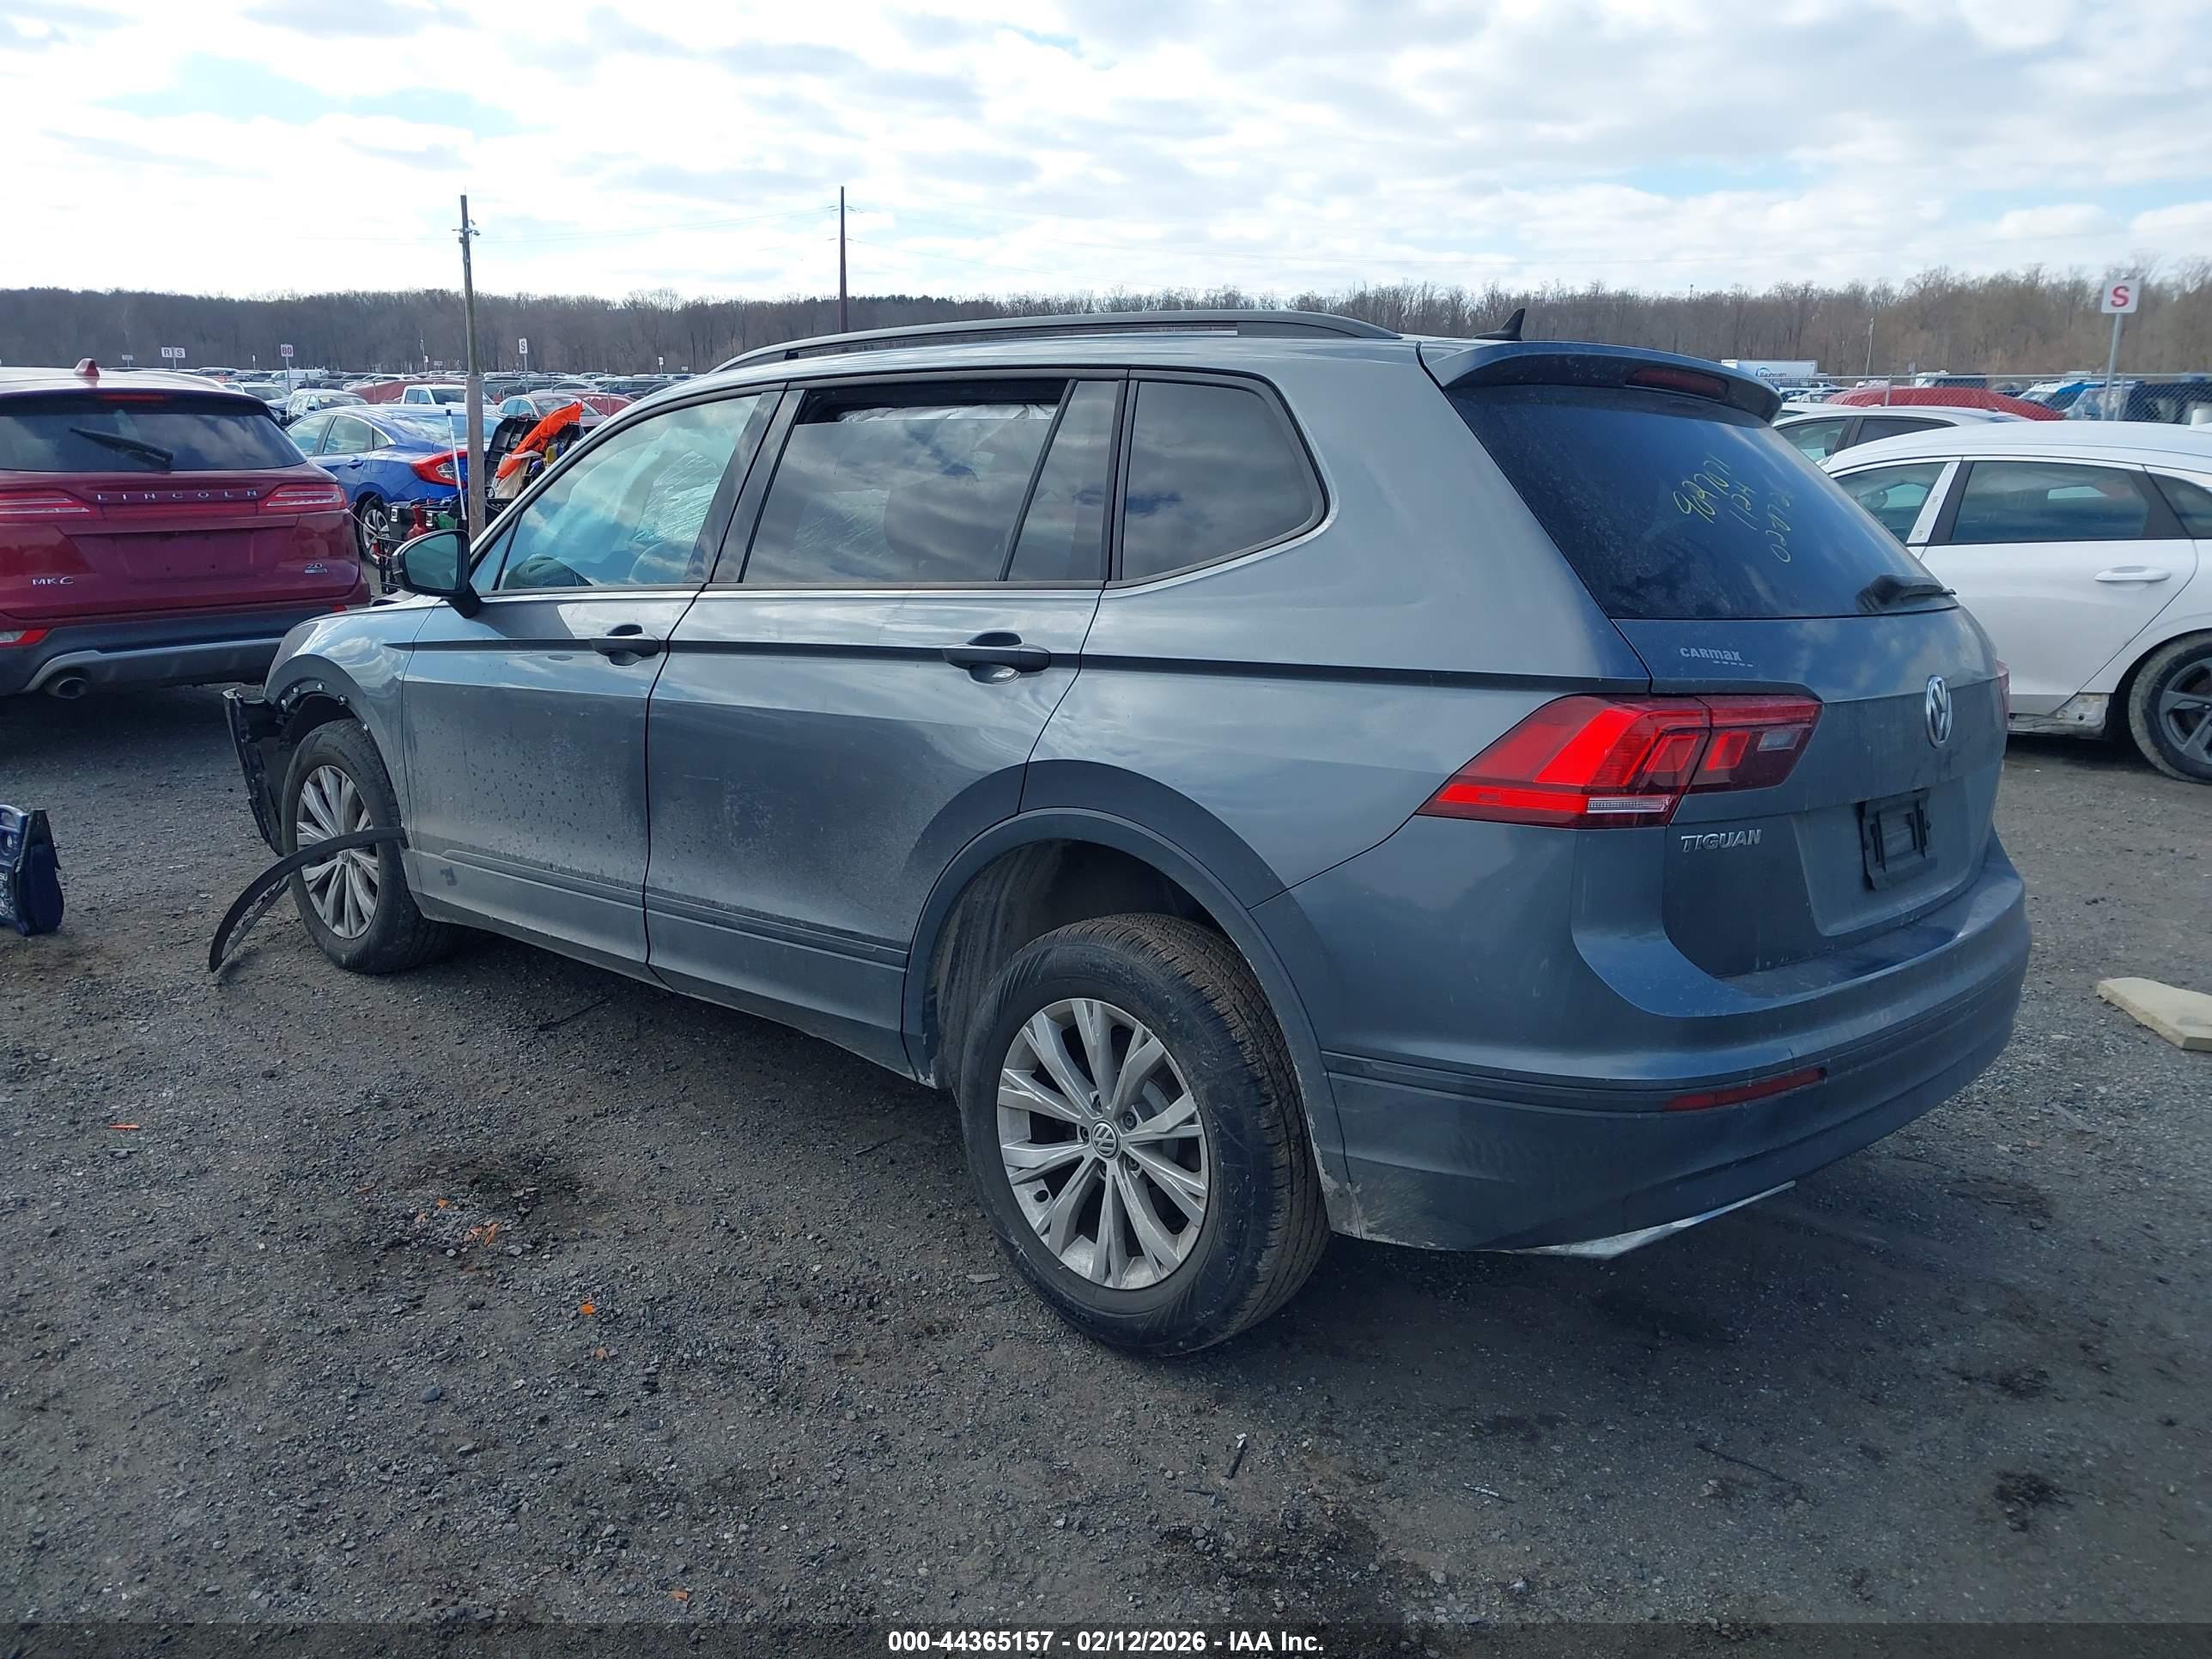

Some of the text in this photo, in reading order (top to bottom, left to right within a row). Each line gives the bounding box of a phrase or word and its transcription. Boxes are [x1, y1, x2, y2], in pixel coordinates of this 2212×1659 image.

[2110, 285, 2130, 307] S
[520, 340, 526, 351] S
[96, 490, 257, 501] LINCOLN
[32, 576, 75, 586] MKC
[1680, 829, 1762, 853] TIGUAN
